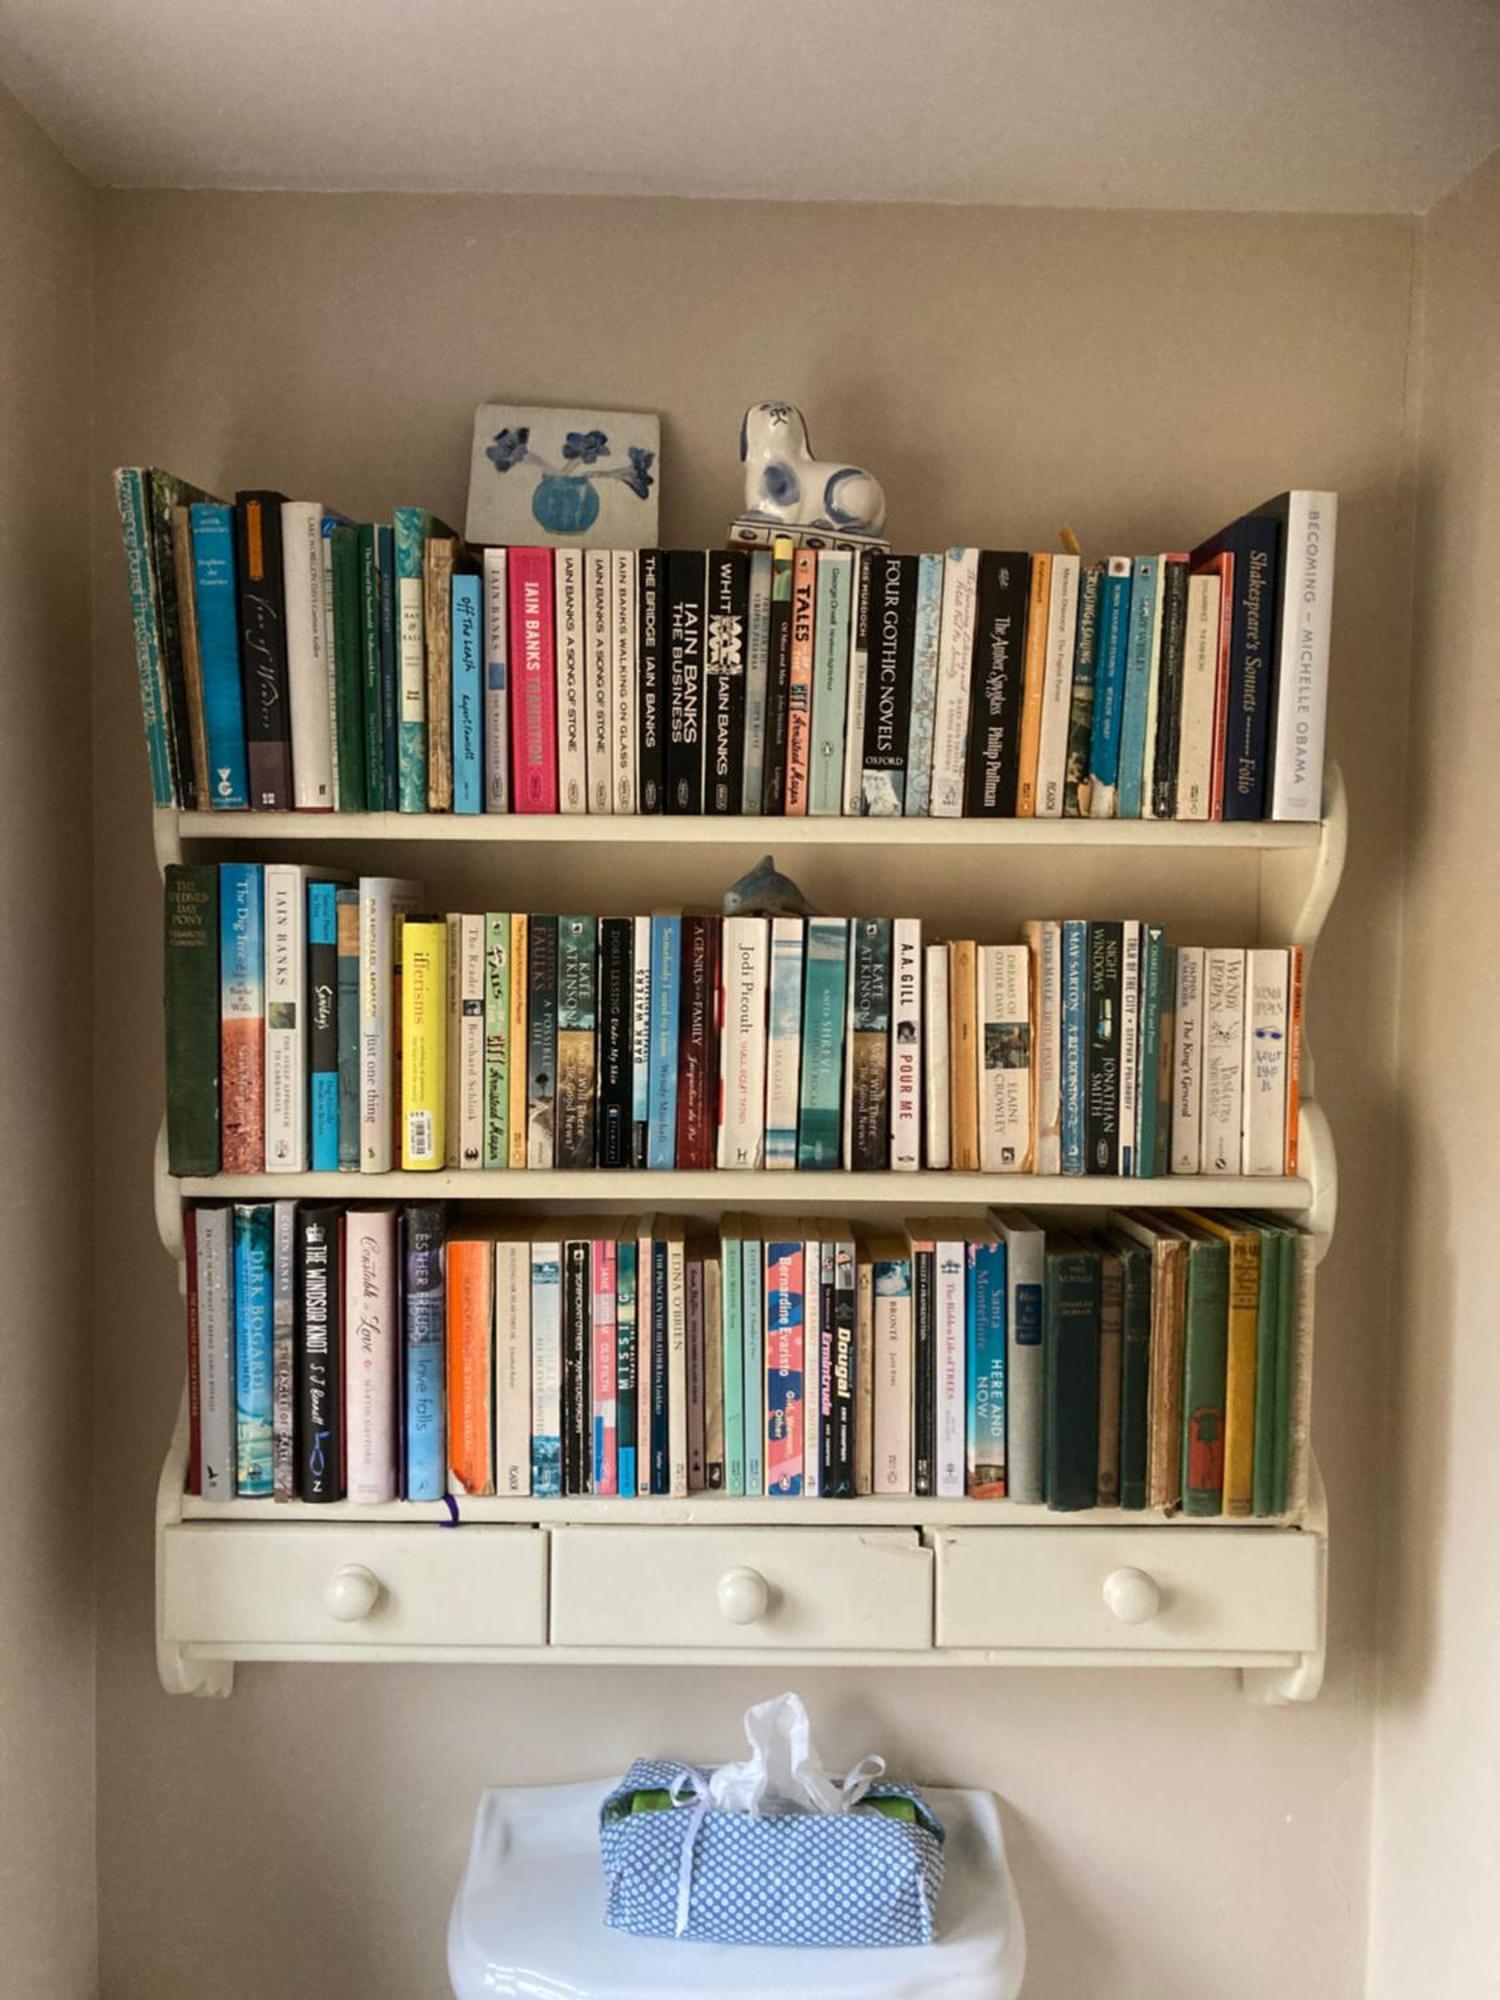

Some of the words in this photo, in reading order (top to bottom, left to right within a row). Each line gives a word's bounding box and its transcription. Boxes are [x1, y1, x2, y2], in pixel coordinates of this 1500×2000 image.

[565, 557, 575, 583] IAIN
[595, 559, 605, 585] IAIN
[618, 557, 628, 585] IAIN
[645, 557, 656, 587] THE
[861, 561, 869, 582] IRIS
[1302, 510, 1320, 603] BECOMING
[491, 570, 501, 597] IAIN
[525, 583, 540, 614] IAIN
[720, 563, 731, 614] WHIT
[883, 560, 901, 606] FOUR
[1242, 551, 1267, 650] Shakespeare's
[244, 595, 273, 628] Year
[457, 597, 473, 616] Off
[565, 586, 576, 632] BANKS
[595, 587, 605, 633] BANKS
[618, 588, 628, 634] BANKS
[645, 591, 655, 647] BRIDGE
[672, 602, 683, 640] THE
[795, 585, 810, 641] TALES
[859, 584, 868, 637] MURDOCH
[459, 618, 474, 637] The
[491, 606, 501, 650] BANKS
[566, 636, 576, 645] A
[595, 638, 605, 648] A
[683, 603, 698, 654] IAIN
[992, 616, 1010, 636] The
[247, 630, 275, 663] of
[525, 620, 541, 671] BANKS
[880, 611, 899, 681] GOTHIC
[989, 636, 1010, 672] Amber
[566, 647, 576, 686] SONG
[595, 650, 605, 688] SONG
[619, 638, 628, 698] WALKING
[645, 657, 656, 687] IAIN
[1240, 656, 1262, 712] Sonnets
[1297, 629, 1315, 713] MICHELLE
[250, 664, 279, 729] Wonders
[567, 689, 577, 706] OF
[596, 690, 605, 708] OF
[619, 702, 628, 722] ON
[672, 647, 683, 743] BUSINESS
[683, 665, 697, 743] BANKS
[717, 677, 728, 711] IAIN
[986, 672, 1008, 715] Spyglass
[567, 708, 577, 752] STONE
[596, 710, 606, 754] STONE
[645, 693, 655, 748] BANKS
[877, 686, 896, 752] NOVELS
[619, 725, 629, 769] GLASS
[716, 714, 728, 775] BANKS
[983, 726, 1003, 759] Philip
[1294, 721, 1310, 784] OBAMA
[865, 757, 903, 767] OXFORD
[1237, 757, 1257, 795] Folio
[789, 767, 805, 806] Maupin
[983, 761, 1002, 806] Pullman
[235, 880, 248, 906] The
[277, 891, 287, 926] IAIN
[235, 910, 248, 931] Dig
[469, 927, 478, 950] The
[235, 934, 248, 959] Tree
[277, 934, 287, 986] BANKS
[532, 927, 545, 992] FAULKS
[738, 943, 755, 976] Jodi
[901, 943, 914, 970] A.A.
[1069, 932, 1080, 958] MAY
[1092, 929, 1104, 991] WINDOWS
[1106, 940, 1116, 982] NIGHT
[414, 952, 429, 1024] ifferisms
[469, 954, 478, 994] Reader
[566, 943, 578, 1020] ATKINSON
[580, 962, 590, 999] KATE
[860, 945, 872, 1022] ATKINSON
[873, 963, 884, 1000] KATE
[994, 951, 1005, 988] OTHER
[1007, 954, 1016, 1000] DREAMS
[1044, 966, 1054, 1001] MAYLE
[1069, 961, 1080, 1011] SARTON
[611, 966, 620, 1014] LESSING
[634, 970, 643, 1020] WATERS
[739, 981, 755, 1034] Picoult
[901, 974, 914, 1006] GILL
[994, 992, 1005, 1019] DAYS
[1007, 1002, 1016, 1015] OF
[364, 1034, 378, 1057] just
[610, 1018, 618, 1046] Under
[634, 1025, 643, 1064] DARK
[1069, 1024, 1080, 1034] A
[1182, 1019, 1194, 1041] The
[468, 1022, 478, 1076] Bernhard
[610, 1049, 618, 1063] My
[773, 1048, 782, 1067] SEA
[1182, 1043, 1194, 1074] King's
[364, 1061, 378, 1086] one
[577, 1077, 586, 1099] Will
[610, 1066, 618, 1085] Skin
[773, 1070, 782, 1101] GLASS
[900, 1054, 913, 1093] POUR
[364, 1089, 378, 1123] thing
[468, 1080, 478, 1121] Schlink
[490, 1068, 504, 1119] Armistead
[566, 1085, 576, 1111] Good
[859, 1084, 868, 1112] Good
[900, 1099, 913, 1121] ME
[994, 1074, 1006, 1135] CROWLEY
[1007, 1082, 1018, 1124] ELAINE
[1091, 1073, 1102, 1117] SMITH
[1103, 1057, 1115, 1132] JONATHAN
[1181, 1077, 1193, 1118] General
[565, 1115, 576, 1151] News?
[576, 1104, 586, 1136] There
[858, 1116, 868, 1152] News?
[490, 1121, 504, 1161] Maupin
[251, 1250, 264, 1297] DIRK
[306, 1245, 327, 1266] THE
[415, 1233, 430, 1285] ESTHER
[672, 1253, 683, 1291] EDNA
[306, 1268, 327, 1322] WINDSOR
[778, 1257, 792, 1324] Bernardine
[992, 1289, 1002, 1329] Santa
[673, 1297, 684, 1351] O'BRIEN
[978, 1270, 989, 1351] Montefiore
[306, 1324, 328, 1355] KNOT
[778, 1327, 792, 1377] Evaristo
[310, 1363, 324, 1371] S
[310, 1375, 324, 1385] J
[416, 1359, 431, 1393] love
[600, 1365, 609, 1393] FILTH
[822, 1332, 833, 1416] Ermintrude
[835, 1327, 851, 1398] Dougal
[992, 1360, 1002, 1399] HERE
[310, 1388, 324, 1425] Bennett
[416, 1397, 431, 1431] falls
[978, 1376, 988, 1419] NOW
[774, 1409, 784, 1440] Other
[992, 1403, 1002, 1437] AND
